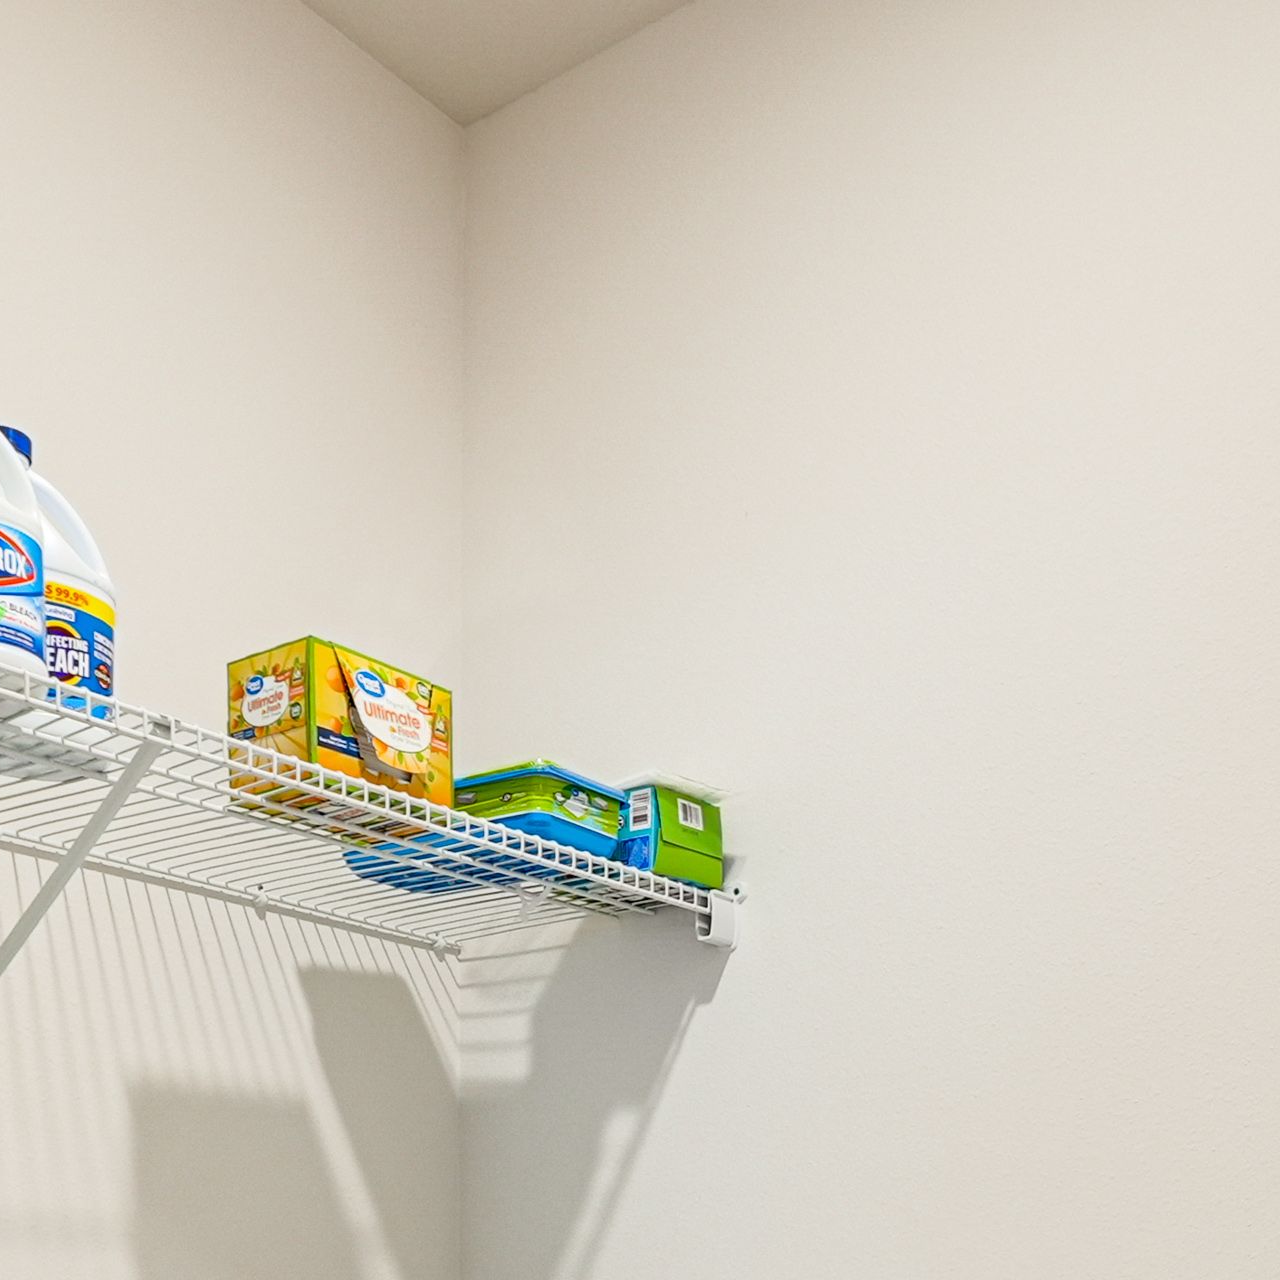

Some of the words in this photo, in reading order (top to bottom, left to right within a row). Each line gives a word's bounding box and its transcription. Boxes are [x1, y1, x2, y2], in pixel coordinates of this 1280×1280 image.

[56, 587, 89, 606] 99.9%
[46, 649, 90, 678] EACH
[247, 691, 284, 712] Ultimate
[363, 701, 422, 730] Ultimate
